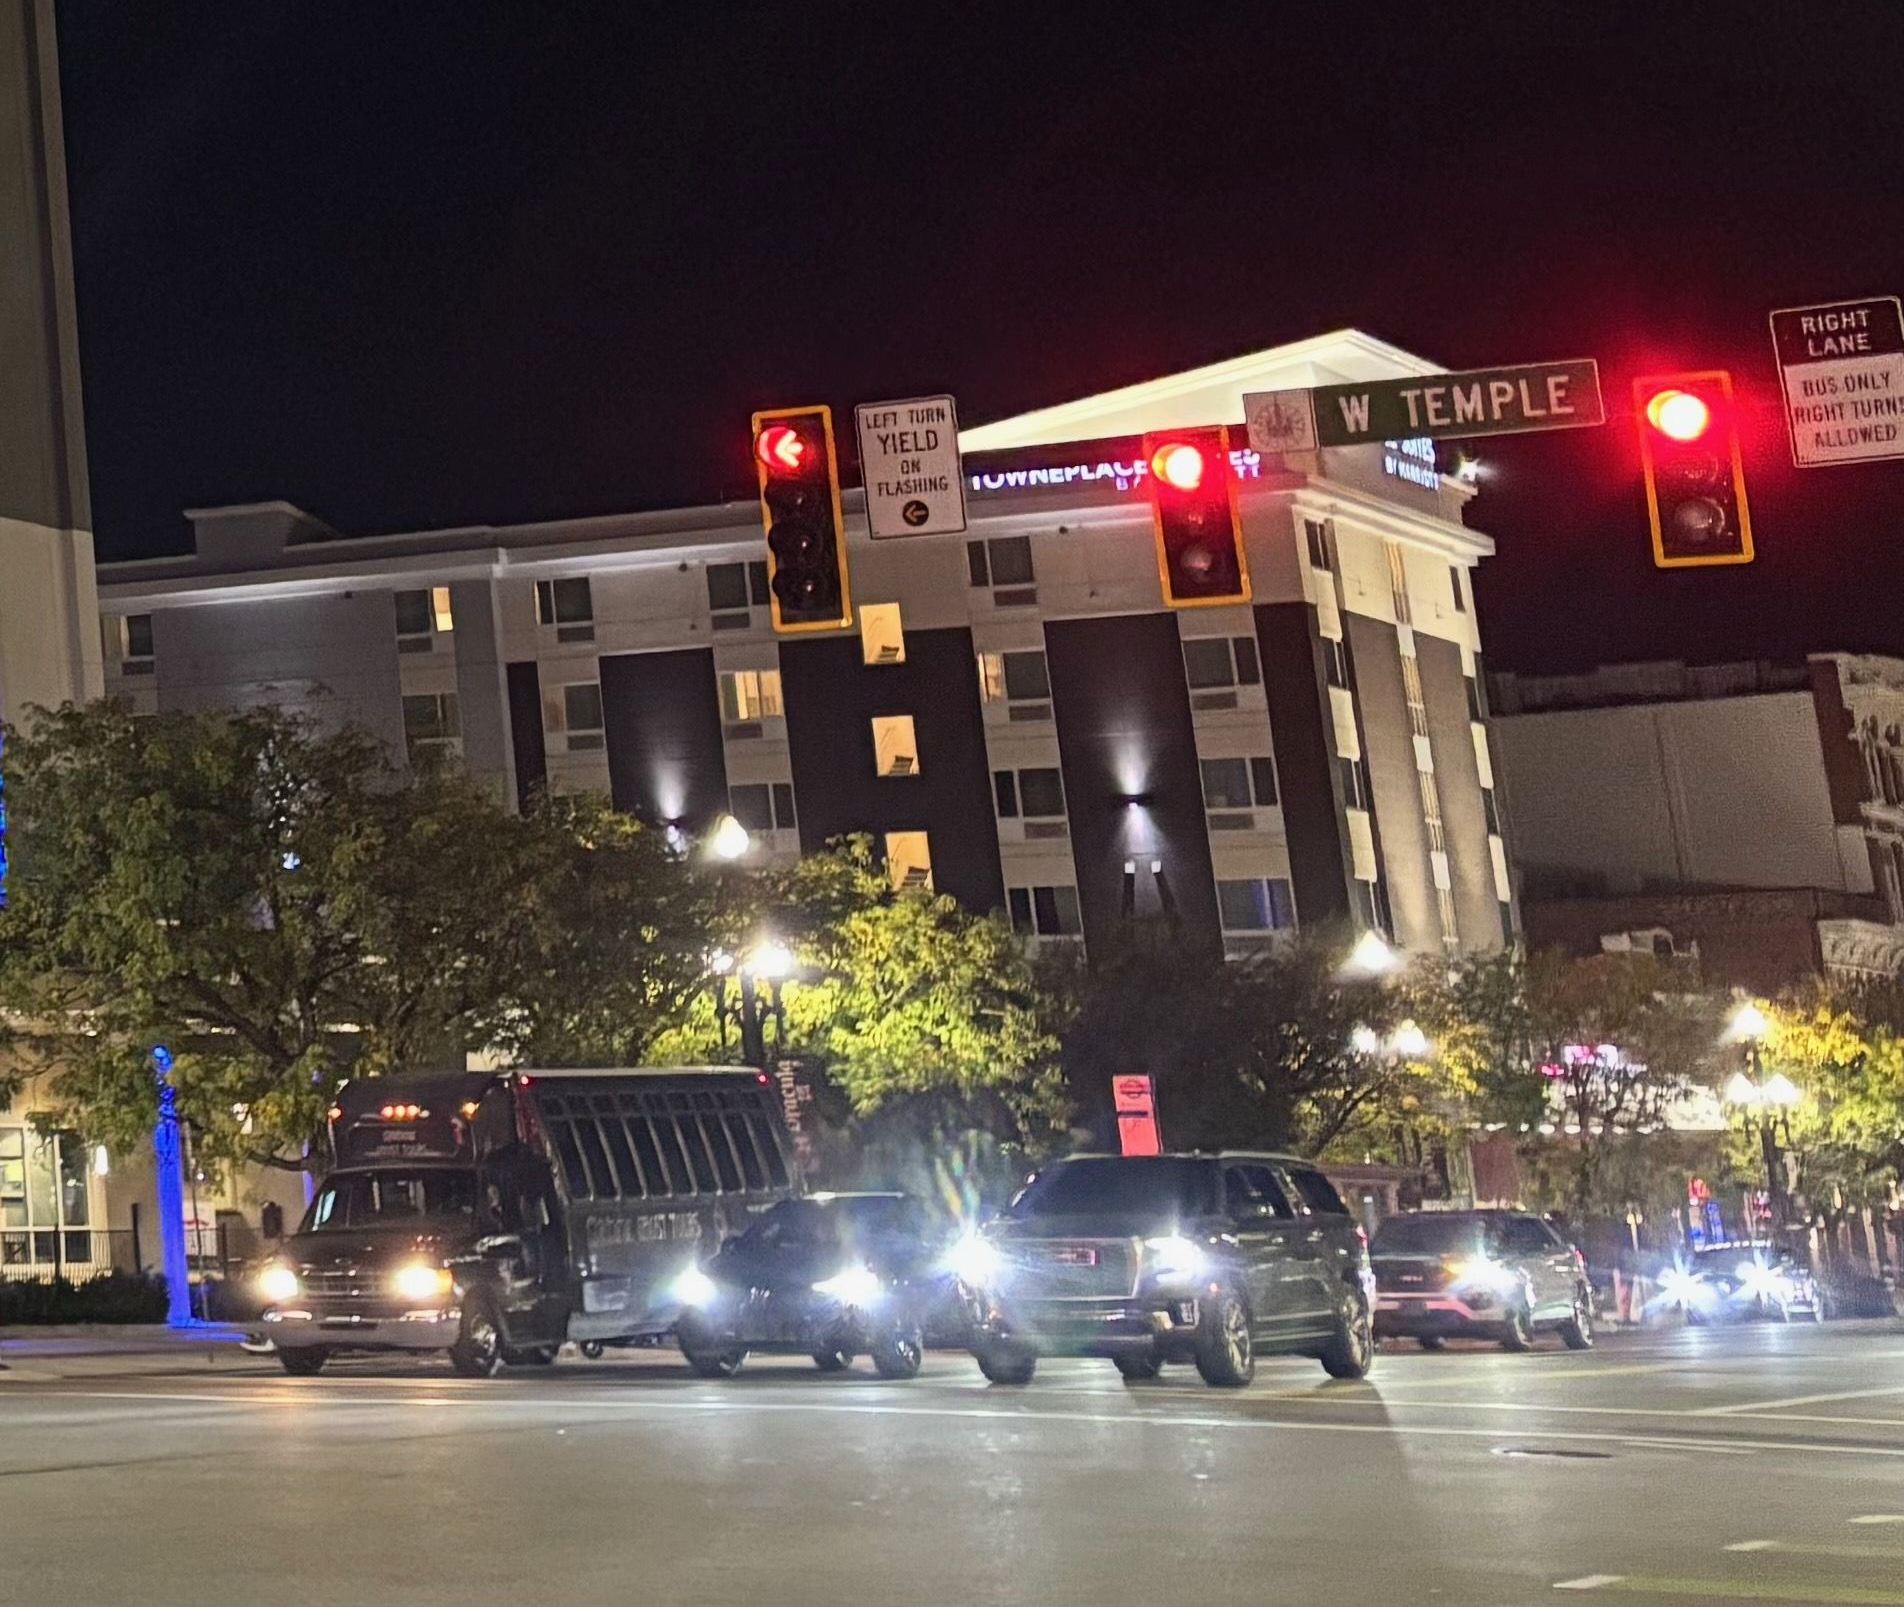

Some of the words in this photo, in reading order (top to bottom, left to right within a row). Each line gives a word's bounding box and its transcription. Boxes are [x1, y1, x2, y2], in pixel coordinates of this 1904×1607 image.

[1801, 309, 1871, 335] RIGHT
[1808, 333, 1872, 357] LANE
[1802, 376, 1838, 397] BUS
[1845, 371, 1890, 393] ONLY
[1339, 395, 1369, 433] W
[1399, 375, 1575, 428] TEMPLE
[1794, 402, 1844, 424] RIGHT
[866, 412, 897, 430] LEFT
[908, 407, 945, 424] TURN
[877, 430, 939, 455] YIELD
[1815, 424, 1897, 448] ALLOWED
[901, 458, 921, 474] ON
[877, 476, 949, 497] FLASHING
